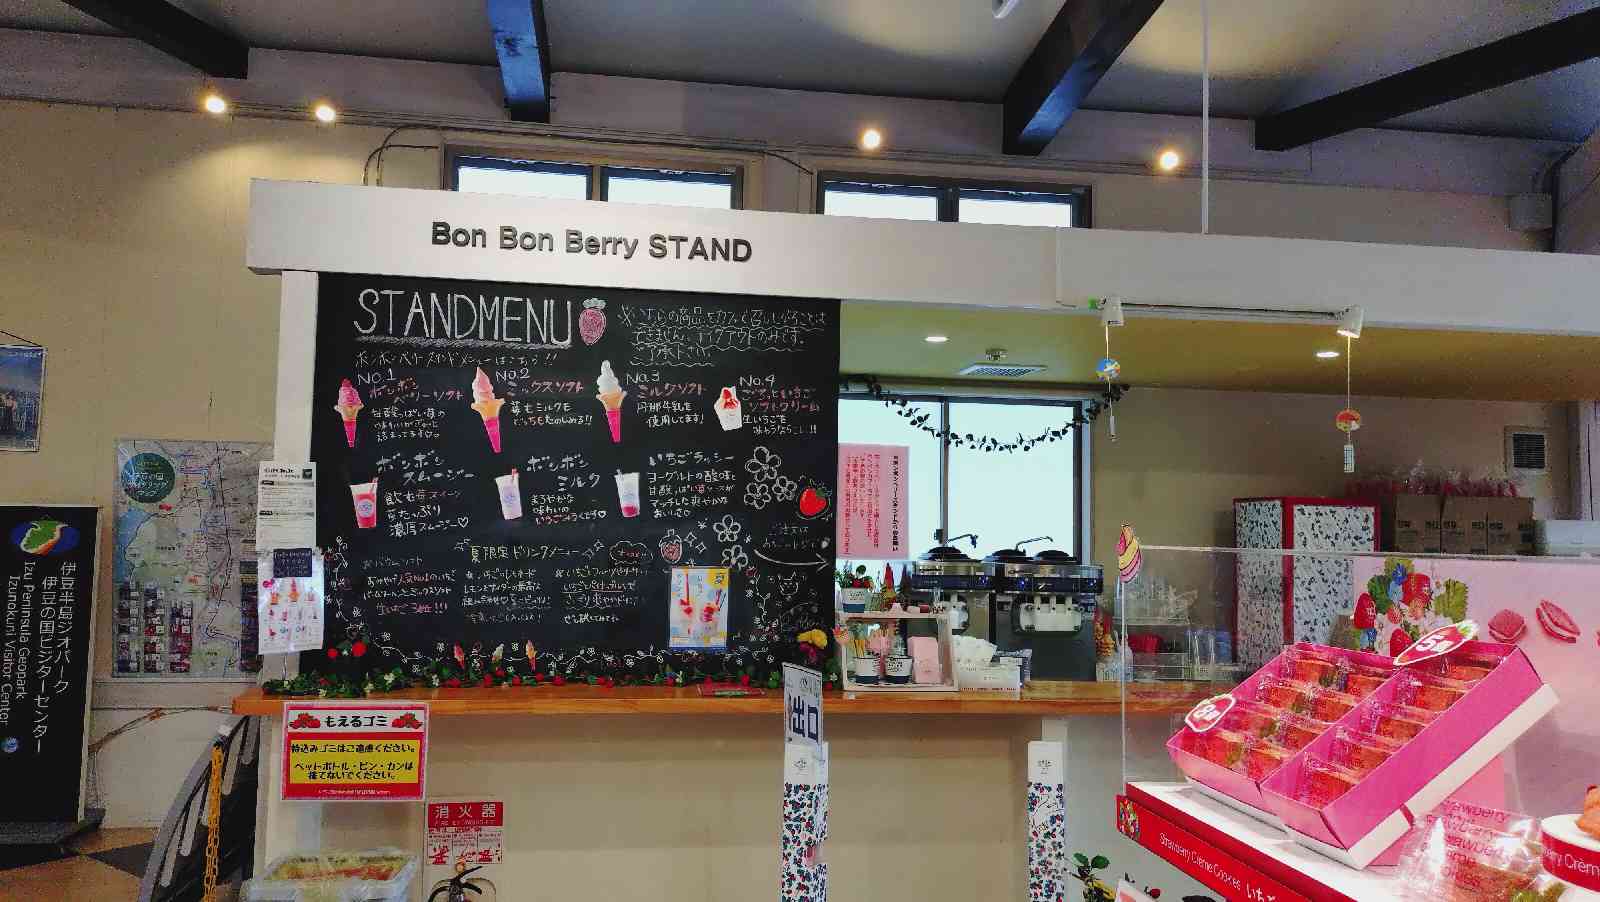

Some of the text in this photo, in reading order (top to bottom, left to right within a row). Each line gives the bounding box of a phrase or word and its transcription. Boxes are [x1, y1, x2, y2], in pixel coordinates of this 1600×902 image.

[431, 221, 753, 263] Bon Bon Berry STAND
[0, 575, 20, 726] Izunokuni Visitor Center
[15, 561, 36, 700] Izu Peninsula Geopark
[32, 575, 58, 753] 伊豆の国ビジターセンター
[54, 561, 77, 694] 伊豆半島ジオパーク
[324, 715, 388, 728] もえるゴミ
[792, 695, 819, 745] 出口
[432, 803, 497, 819] 消火器
